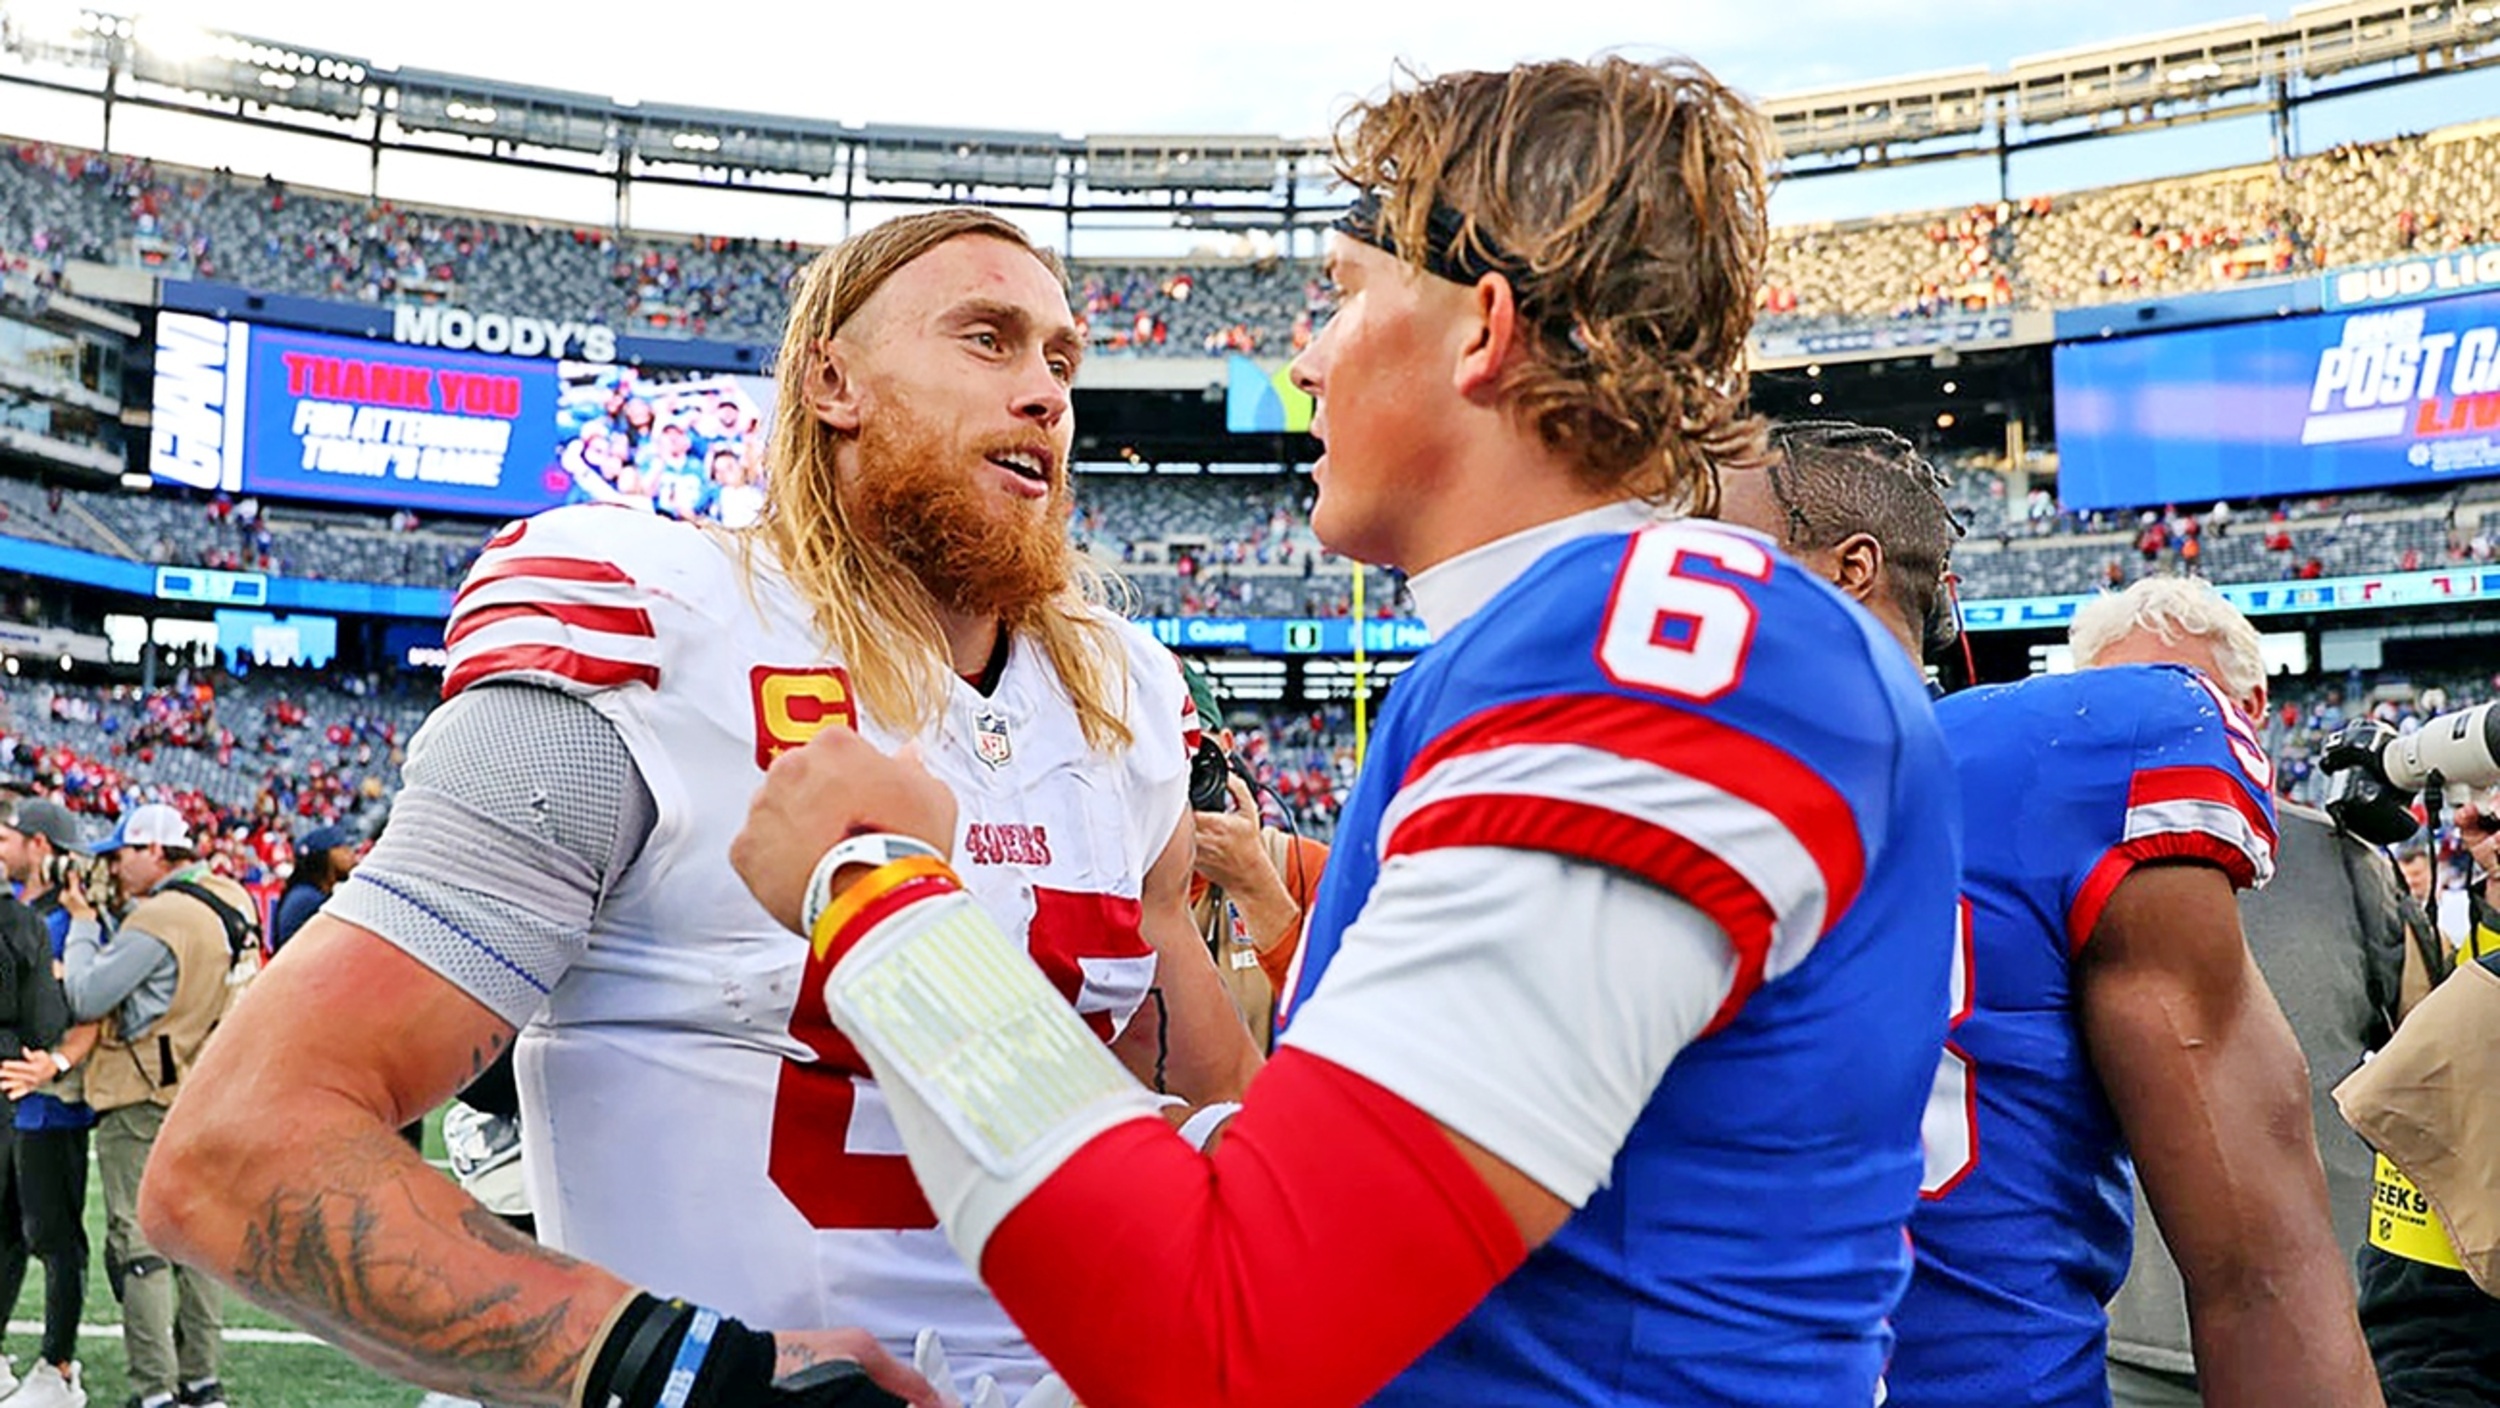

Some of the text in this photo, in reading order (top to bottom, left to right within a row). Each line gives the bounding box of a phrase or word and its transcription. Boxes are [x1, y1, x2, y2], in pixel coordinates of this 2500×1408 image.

[2337, 261, 2431, 304] BUD
[393, 305, 617, 362] MOODY'S
[283, 352, 520, 418] THANK YOU
[2309, 331, 2456, 413] POST
[1593, 523, 1773, 706] 6
[761, 673, 848, 742] C
[965, 822, 1052, 867] 49ERS
